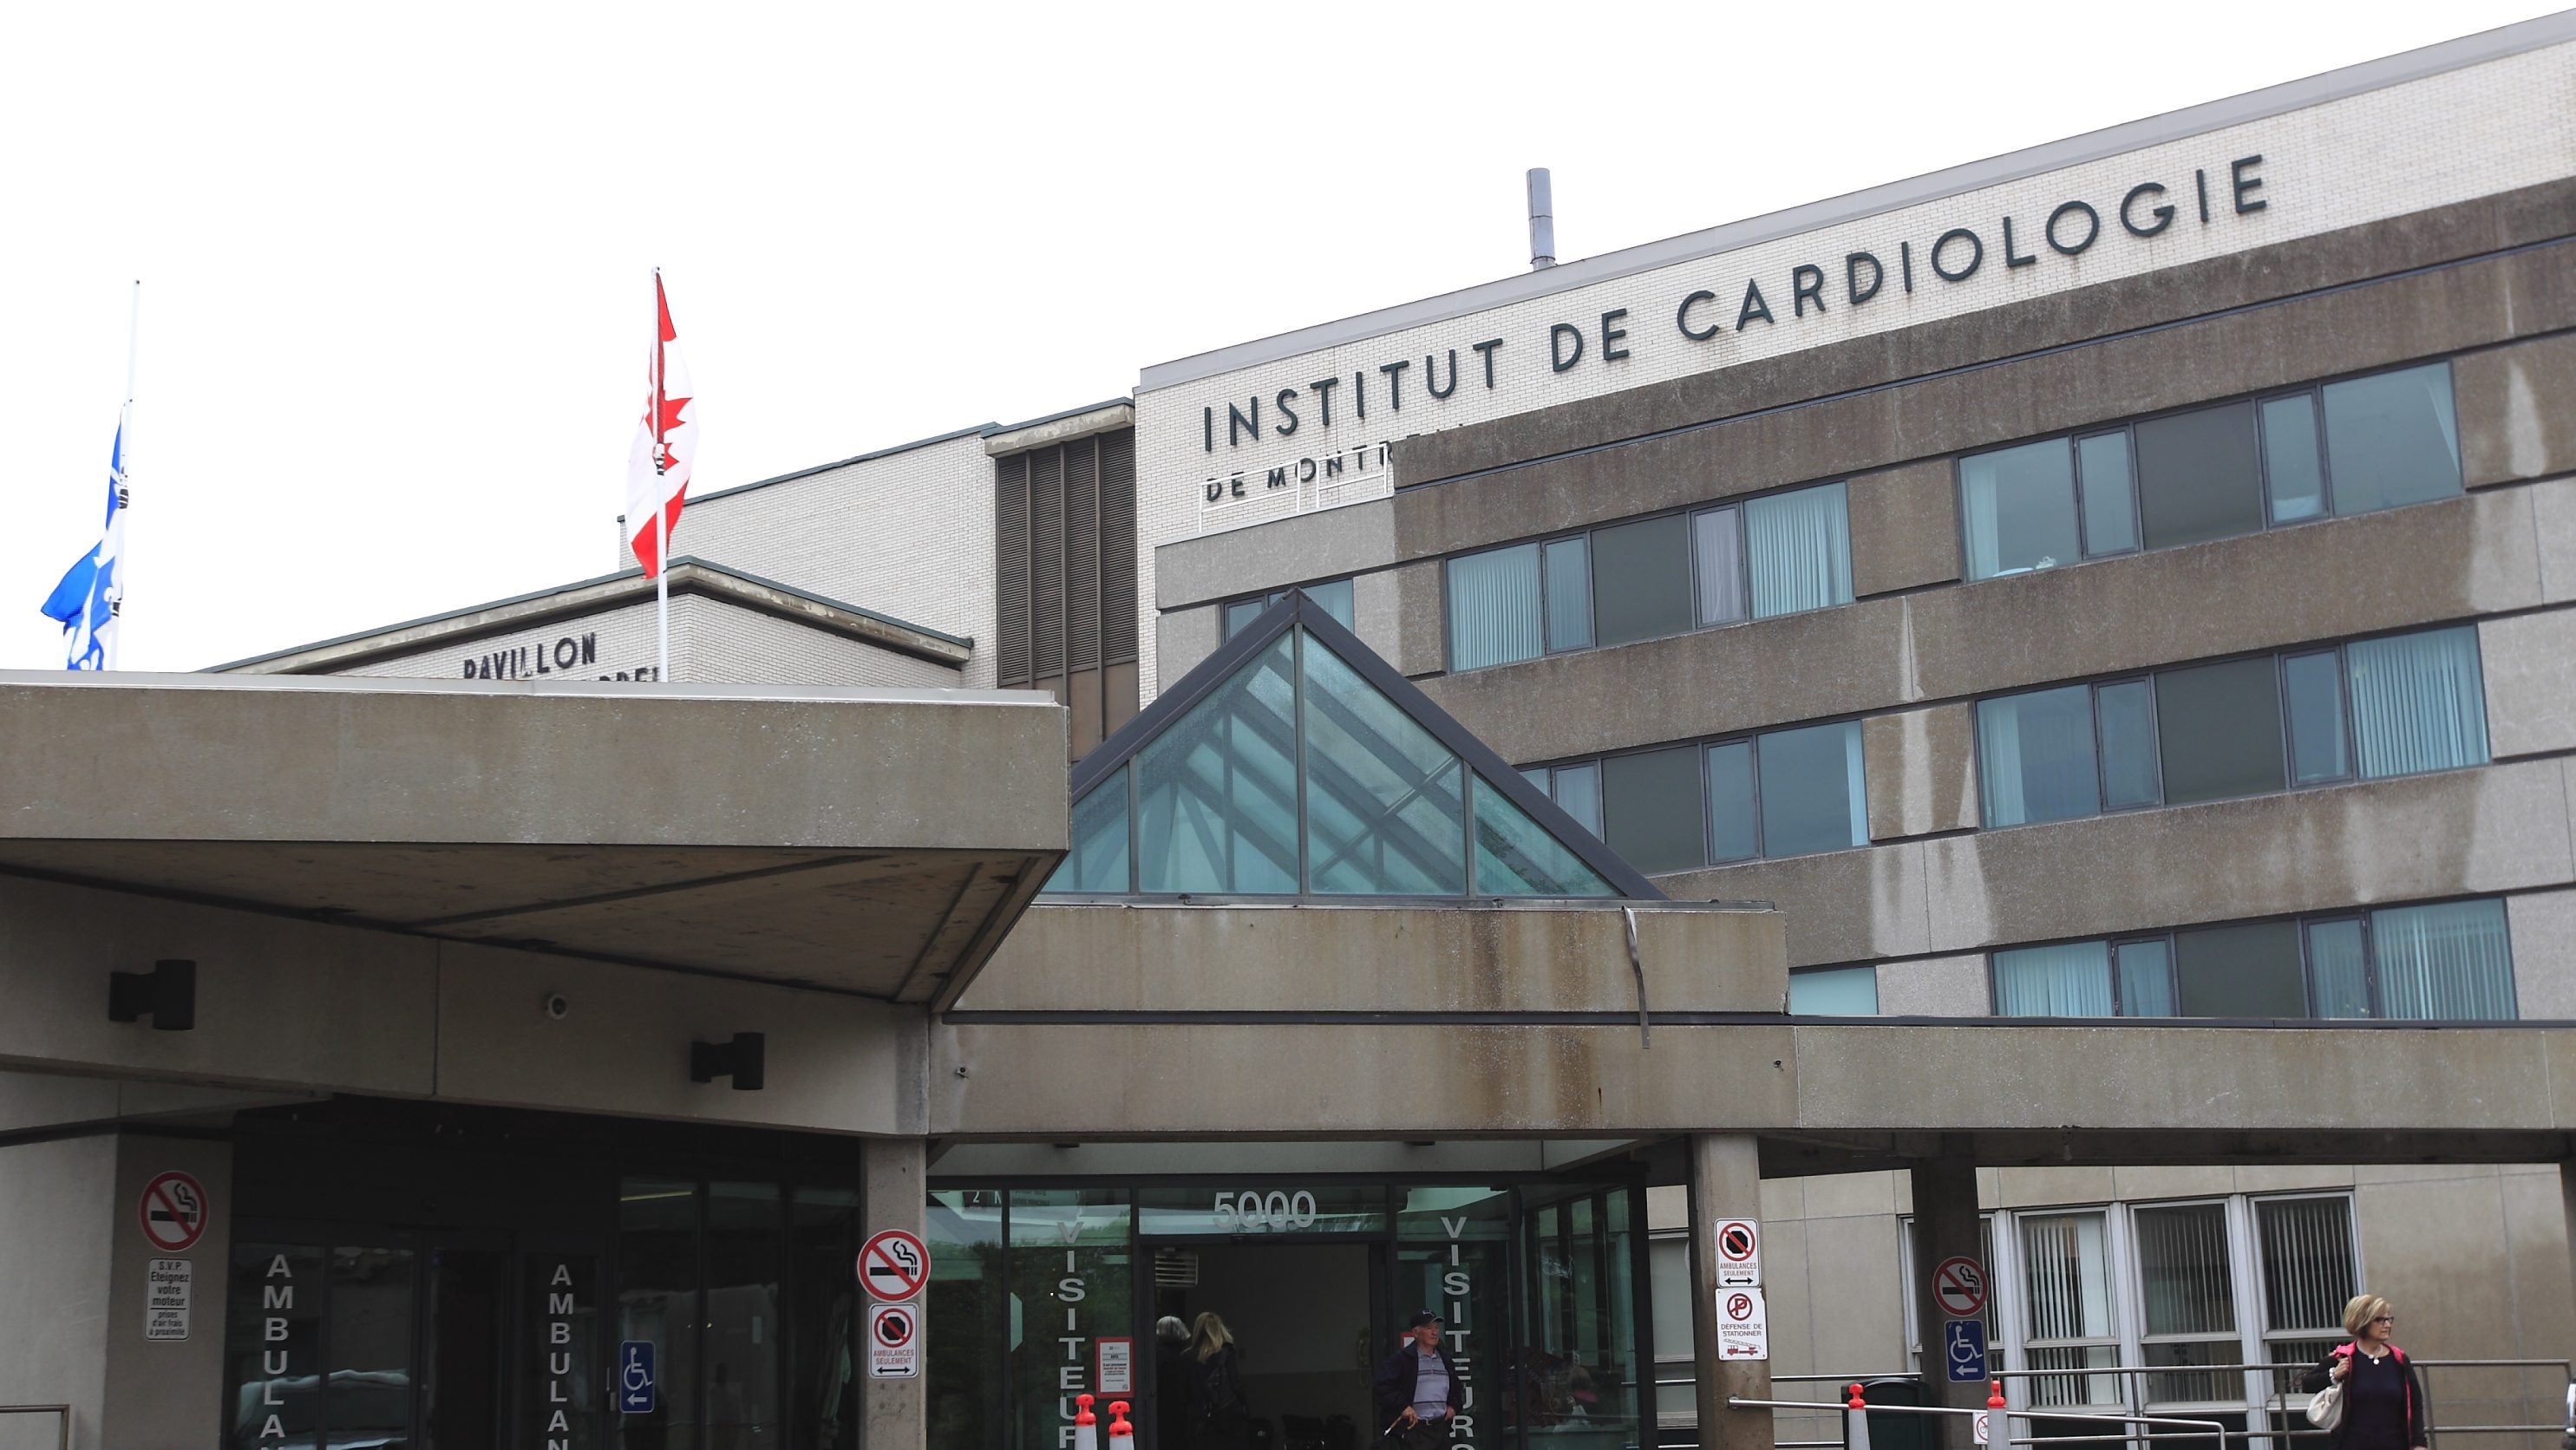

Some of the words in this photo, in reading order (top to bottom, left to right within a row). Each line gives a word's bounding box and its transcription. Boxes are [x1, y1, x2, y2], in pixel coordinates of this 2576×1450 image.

[1204, 337, 1503, 453] INSTITUT
[1550, 308, 1630, 373] DE
[1677, 154, 2266, 341] CARDIOLOGIE
[1206, 471, 1246, 501] DE
[464, 632, 596, 680] PAVILLON
[1213, 1190, 1317, 1229] 5000
[153, 1297, 185, 1306] moteur
[158, 1285, 181, 1295] votre
[260, 1254, 293, 1450] AMBULA
